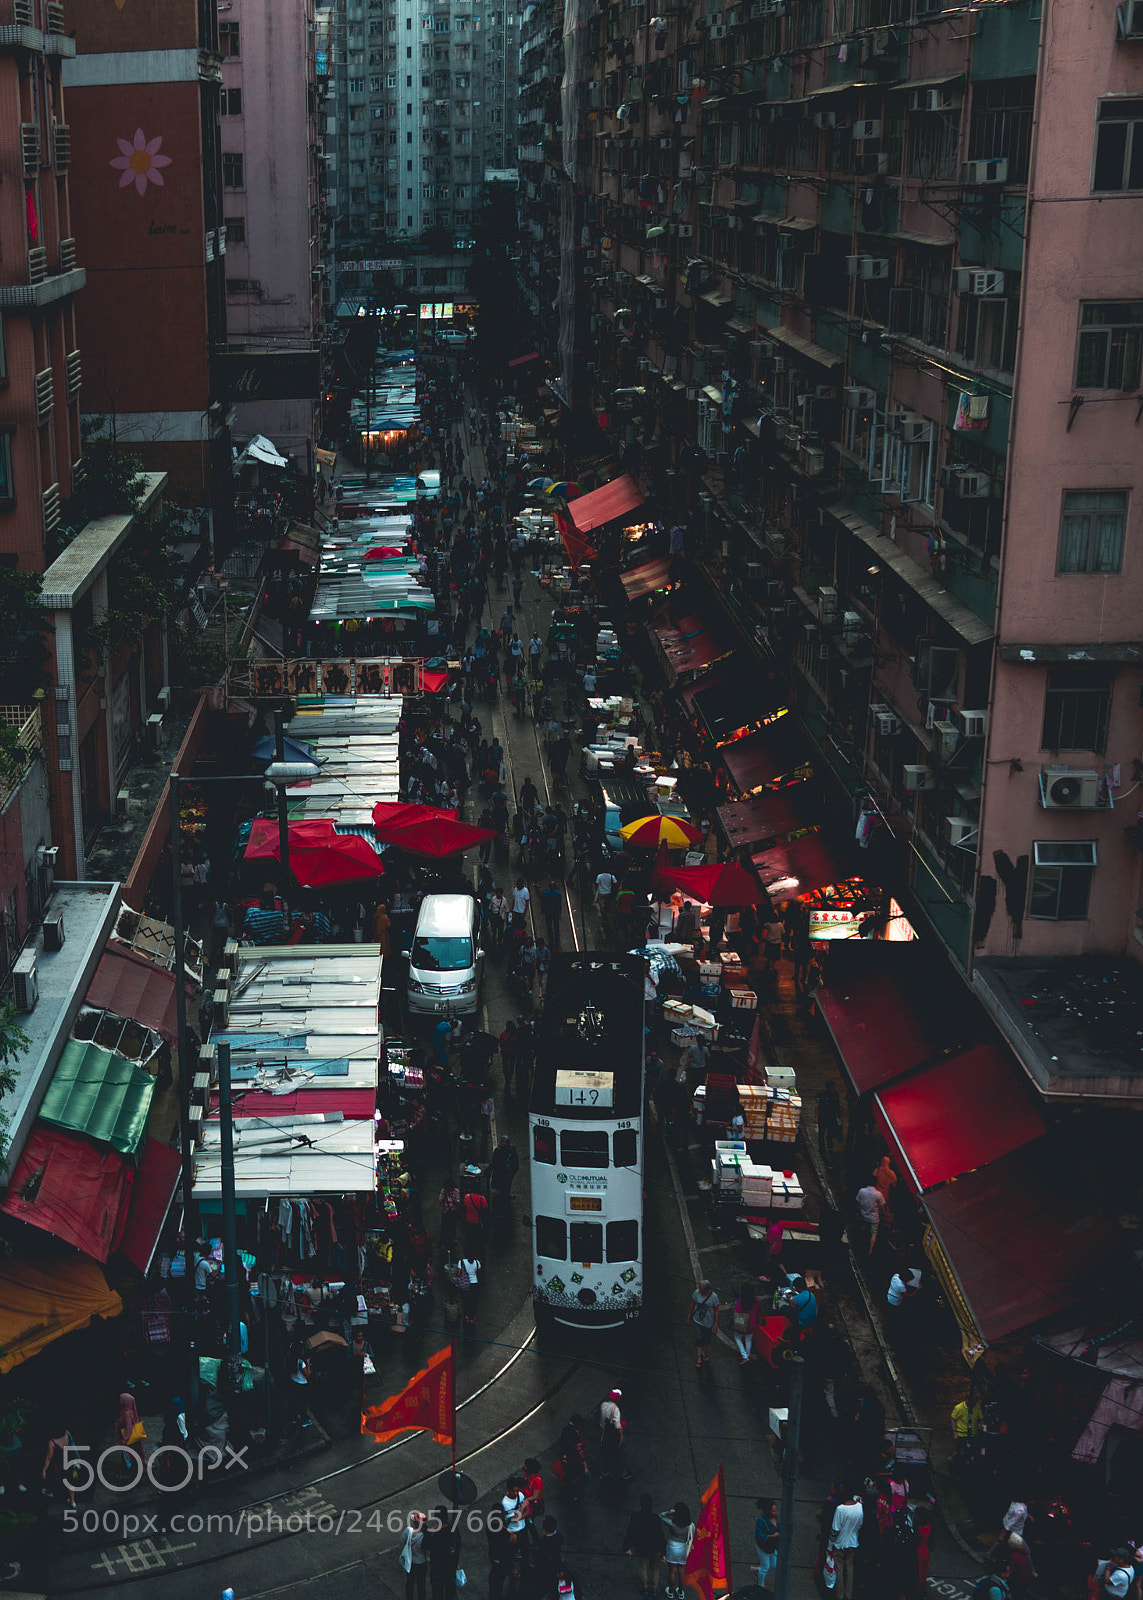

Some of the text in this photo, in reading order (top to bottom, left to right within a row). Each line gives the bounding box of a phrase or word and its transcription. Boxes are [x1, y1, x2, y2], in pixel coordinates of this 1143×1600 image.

[570, 1089, 599, 1105] 149
[537, 1118, 550, 1126] 149
[617, 1121, 631, 1129] 149
[625, 1310, 640, 1320] 149
